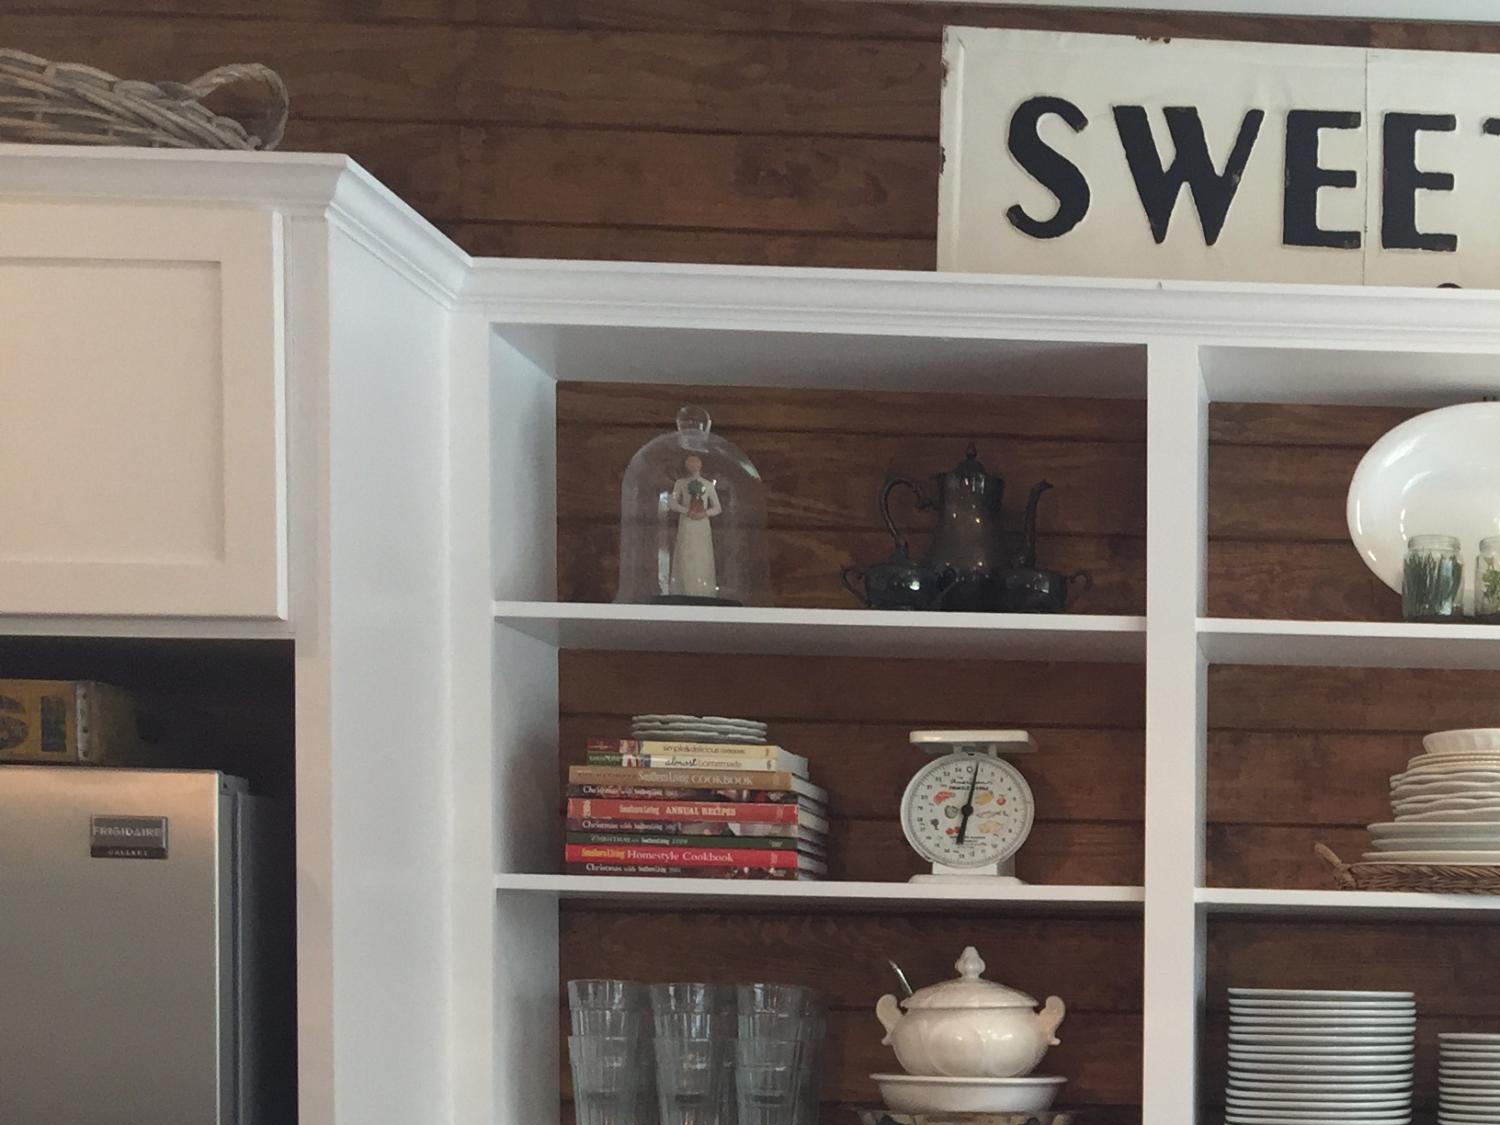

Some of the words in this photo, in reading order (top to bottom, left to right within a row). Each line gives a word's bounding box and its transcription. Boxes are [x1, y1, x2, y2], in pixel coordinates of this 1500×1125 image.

[691, 775, 754, 786] COOKBOOK
[666, 806, 699, 816] ANNUAL
[701, 807, 737, 816] RECIPES
[94, 826, 162, 838] FRIGIDAIRE
[626, 849, 680, 863] Homestyle
[682, 851, 735, 863] Cookbook
[586, 862, 623, 873] Christmas
